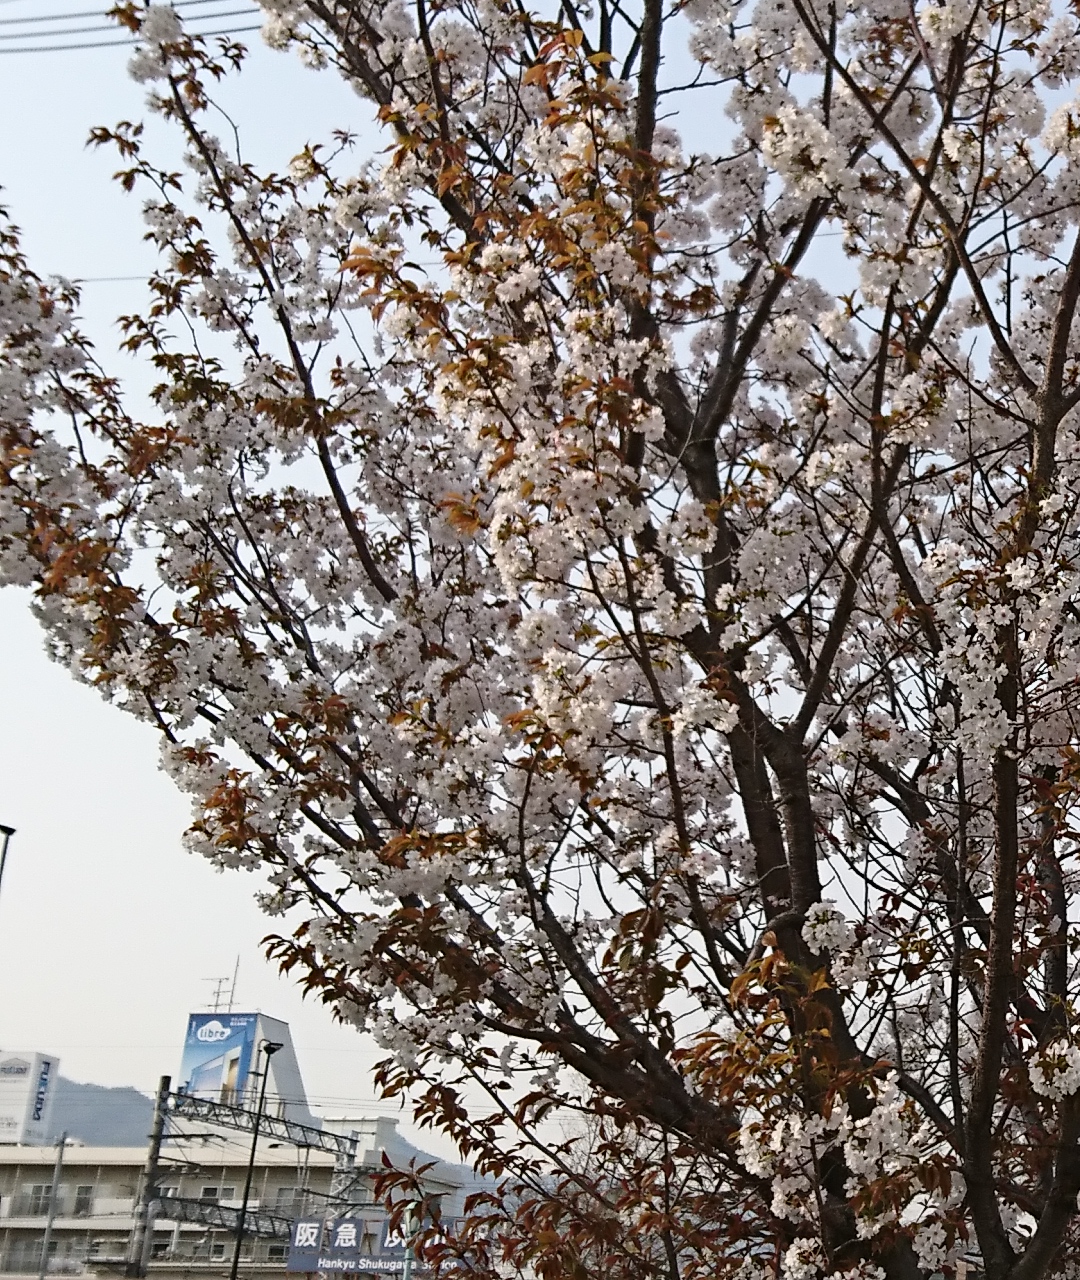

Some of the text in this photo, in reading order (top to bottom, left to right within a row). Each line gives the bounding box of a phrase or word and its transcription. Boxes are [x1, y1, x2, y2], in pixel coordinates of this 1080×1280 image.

[200, 1028, 226, 1038] libre
[294, 1223, 357, 1248] 阪急
[317, 1257, 355, 1270] Hankyu
[358, 1258, 417, 1271] Shukugaa
